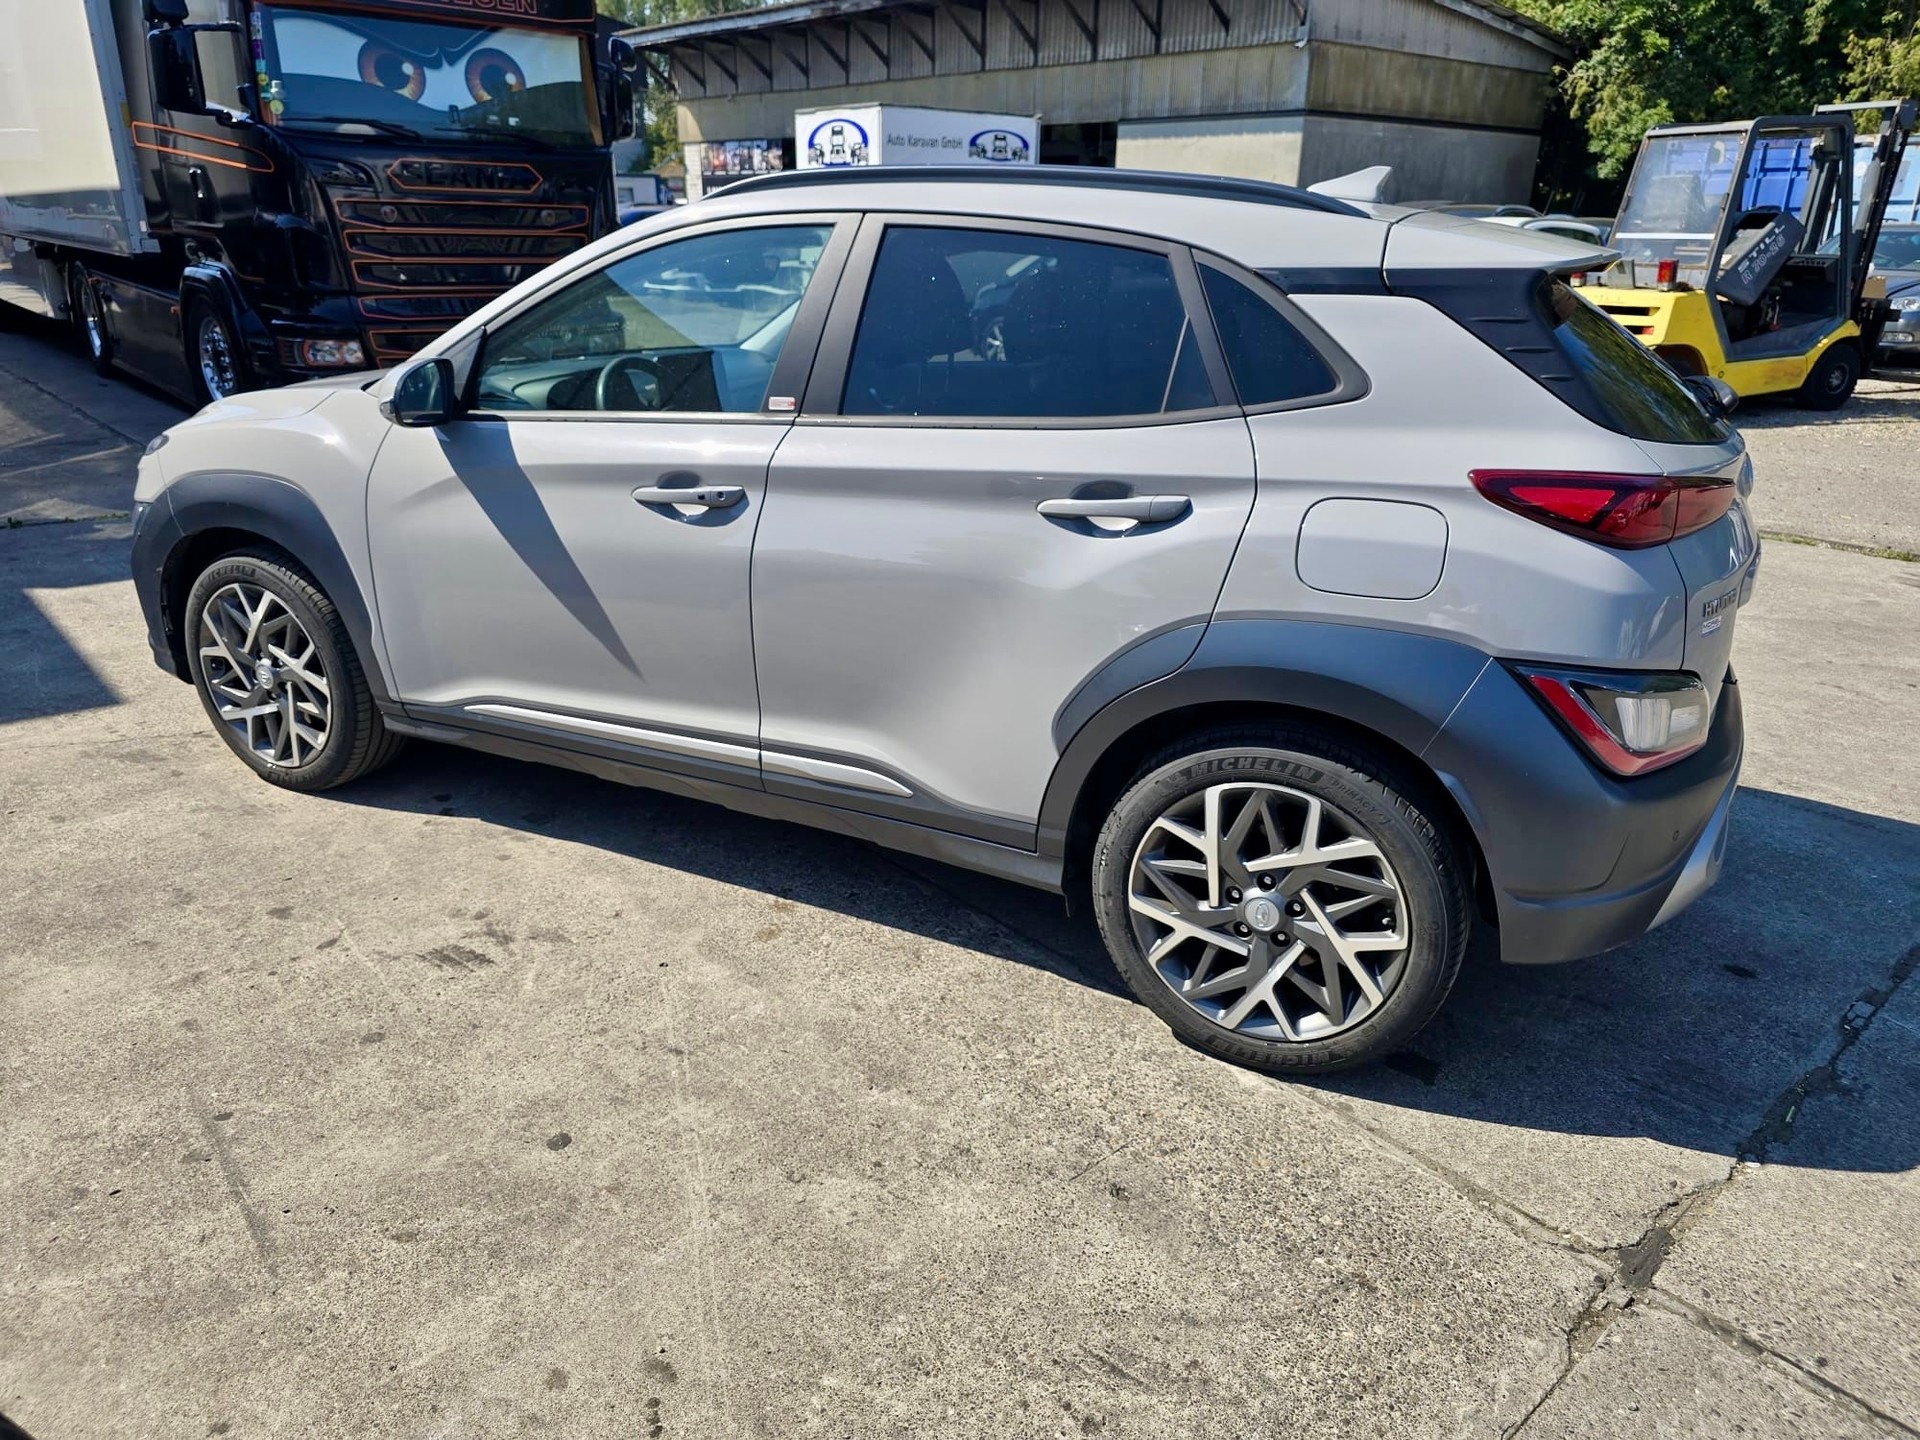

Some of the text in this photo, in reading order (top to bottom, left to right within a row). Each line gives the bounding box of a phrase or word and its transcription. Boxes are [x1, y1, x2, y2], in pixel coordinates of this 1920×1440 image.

[887, 134, 905, 146] Auto
[1738, 225, 1785, 273] STILL
[1190, 756, 1316, 779] MICHELIN
